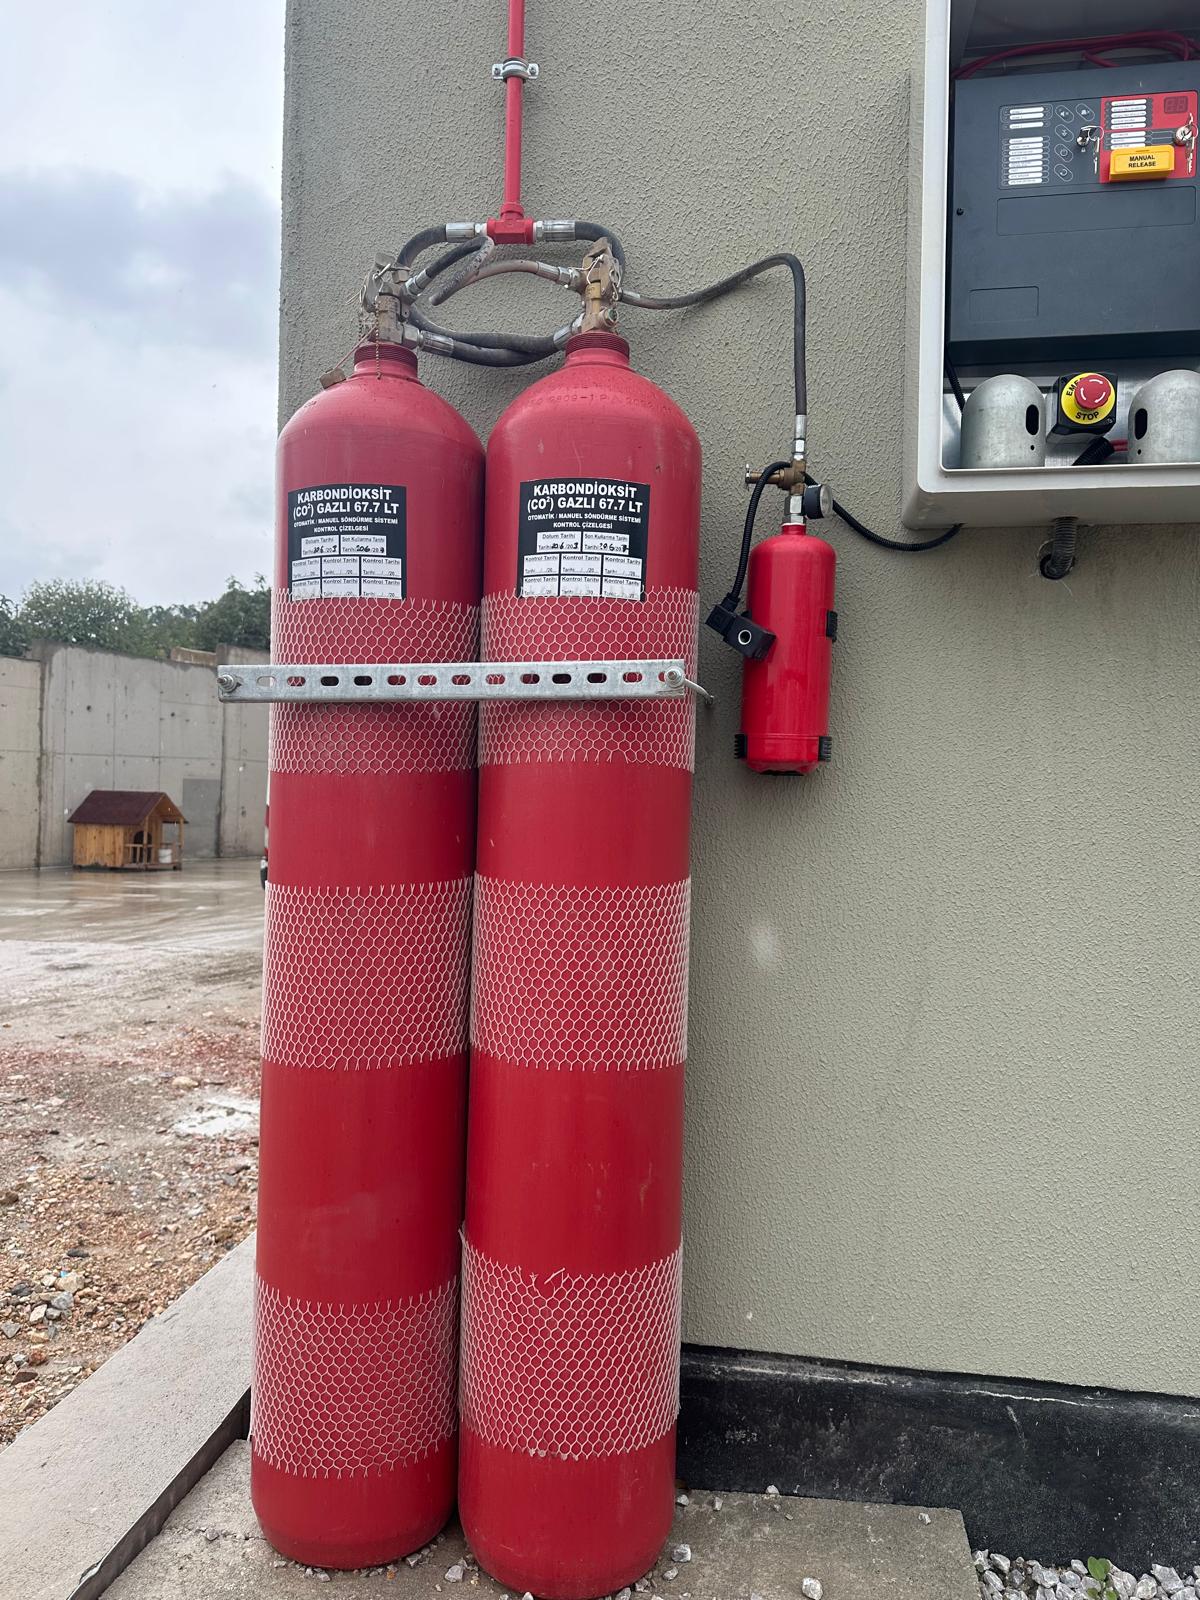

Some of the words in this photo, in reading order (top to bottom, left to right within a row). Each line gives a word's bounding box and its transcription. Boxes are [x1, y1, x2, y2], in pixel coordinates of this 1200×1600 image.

[1076, 411, 1099, 420] STOP
[298, 486, 392, 504] KARBONDİOKSİT
[534, 482, 637, 498] KARBONDİOKSİT
[317, 502, 350, 513] GAZLI
[354, 502, 380, 513] 67.7
[384, 503, 399, 514] LT
[558, 497, 595, 508] GAZLI
[599, 498, 625, 510] 67.7
[628, 501, 643, 513] LT
[619, 515, 641, 523] SİSTEMİ
